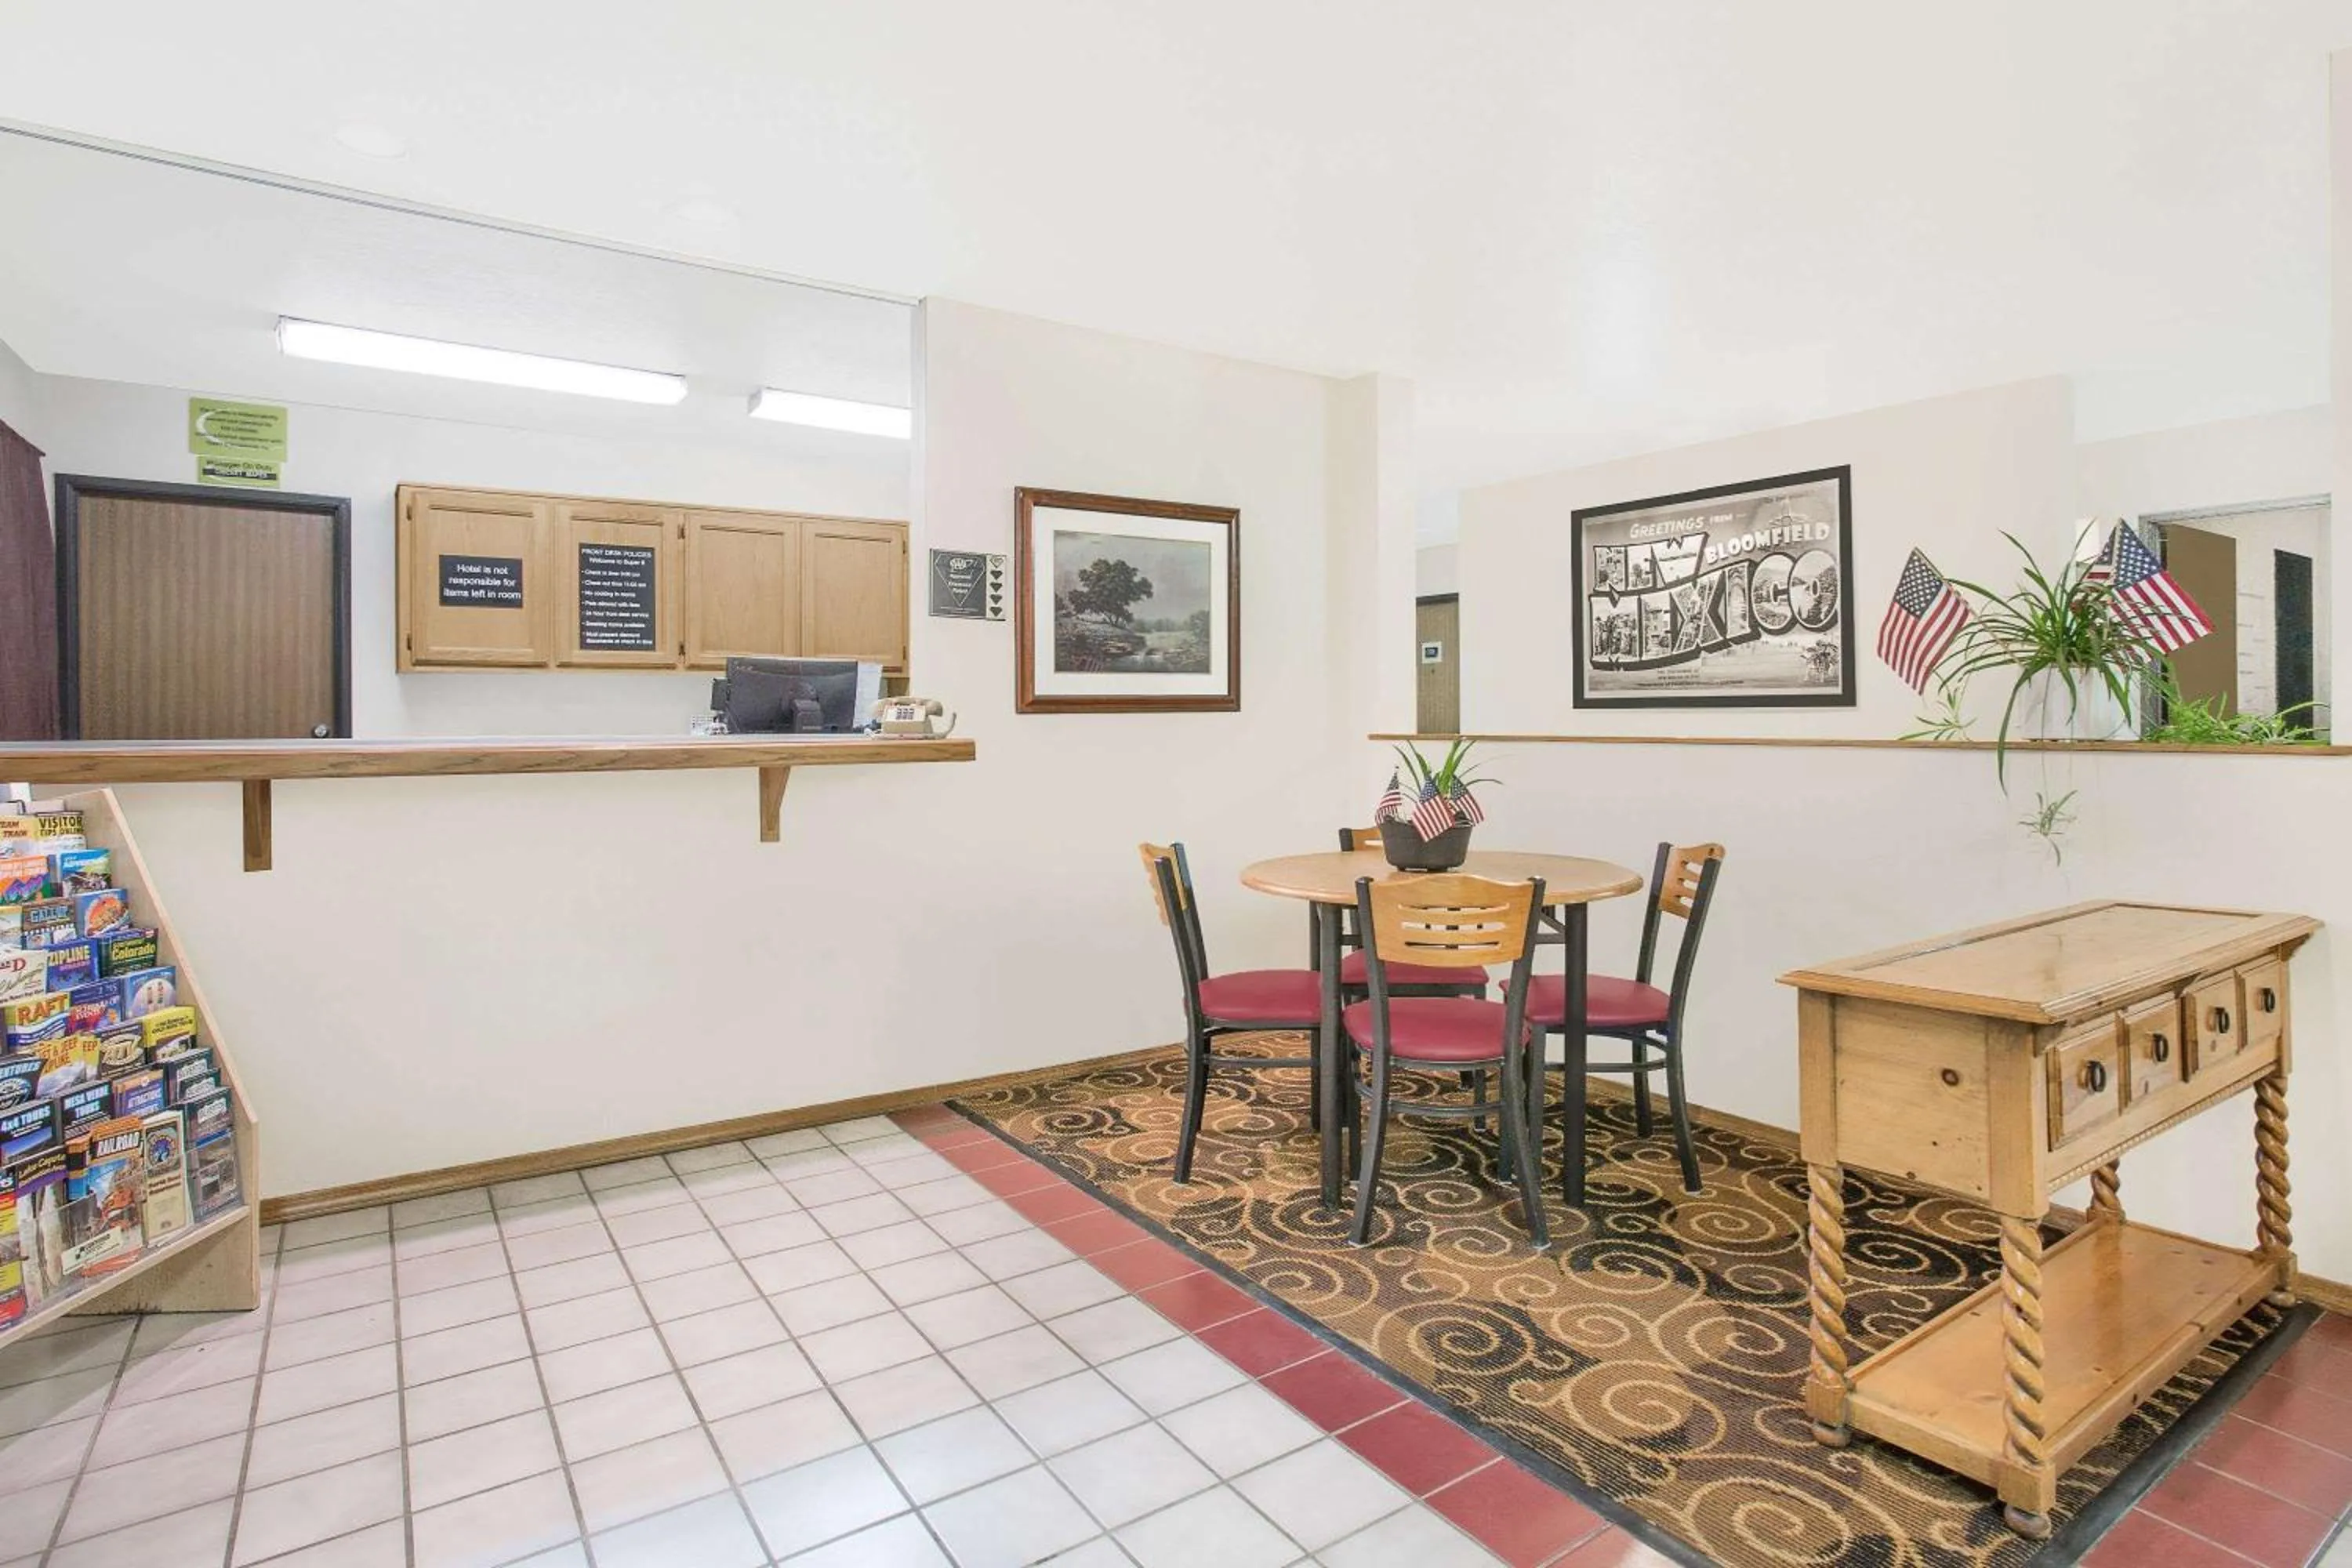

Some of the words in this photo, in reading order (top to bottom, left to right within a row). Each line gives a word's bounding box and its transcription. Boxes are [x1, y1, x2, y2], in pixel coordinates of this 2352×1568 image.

[1630, 516, 1705, 539] GREETINGS
[1704, 522, 1831, 565] BLOOMFIELD
[457, 564, 482, 573] Hotel
[483, 565, 491, 574] is
[493, 566, 508, 575] not
[1593, 532, 1709, 593] NEW
[448, 576, 502, 586] responsible
[503, 579, 516, 587] for
[443, 588, 470, 597] items
[471, 590, 485, 598] left
[1589, 550, 1839, 671] MEXICO
[39, 816, 82, 828] VISITOR
[40, 829, 57, 837] TIPS
[112, 942, 156, 960] Colorado
[17, 993, 68, 1023] RAFT
[21, 1105, 51, 1125] TOURS
[74, 1100, 100, 1118] TOURS
[96, 1131, 140, 1158] RAILROAD
